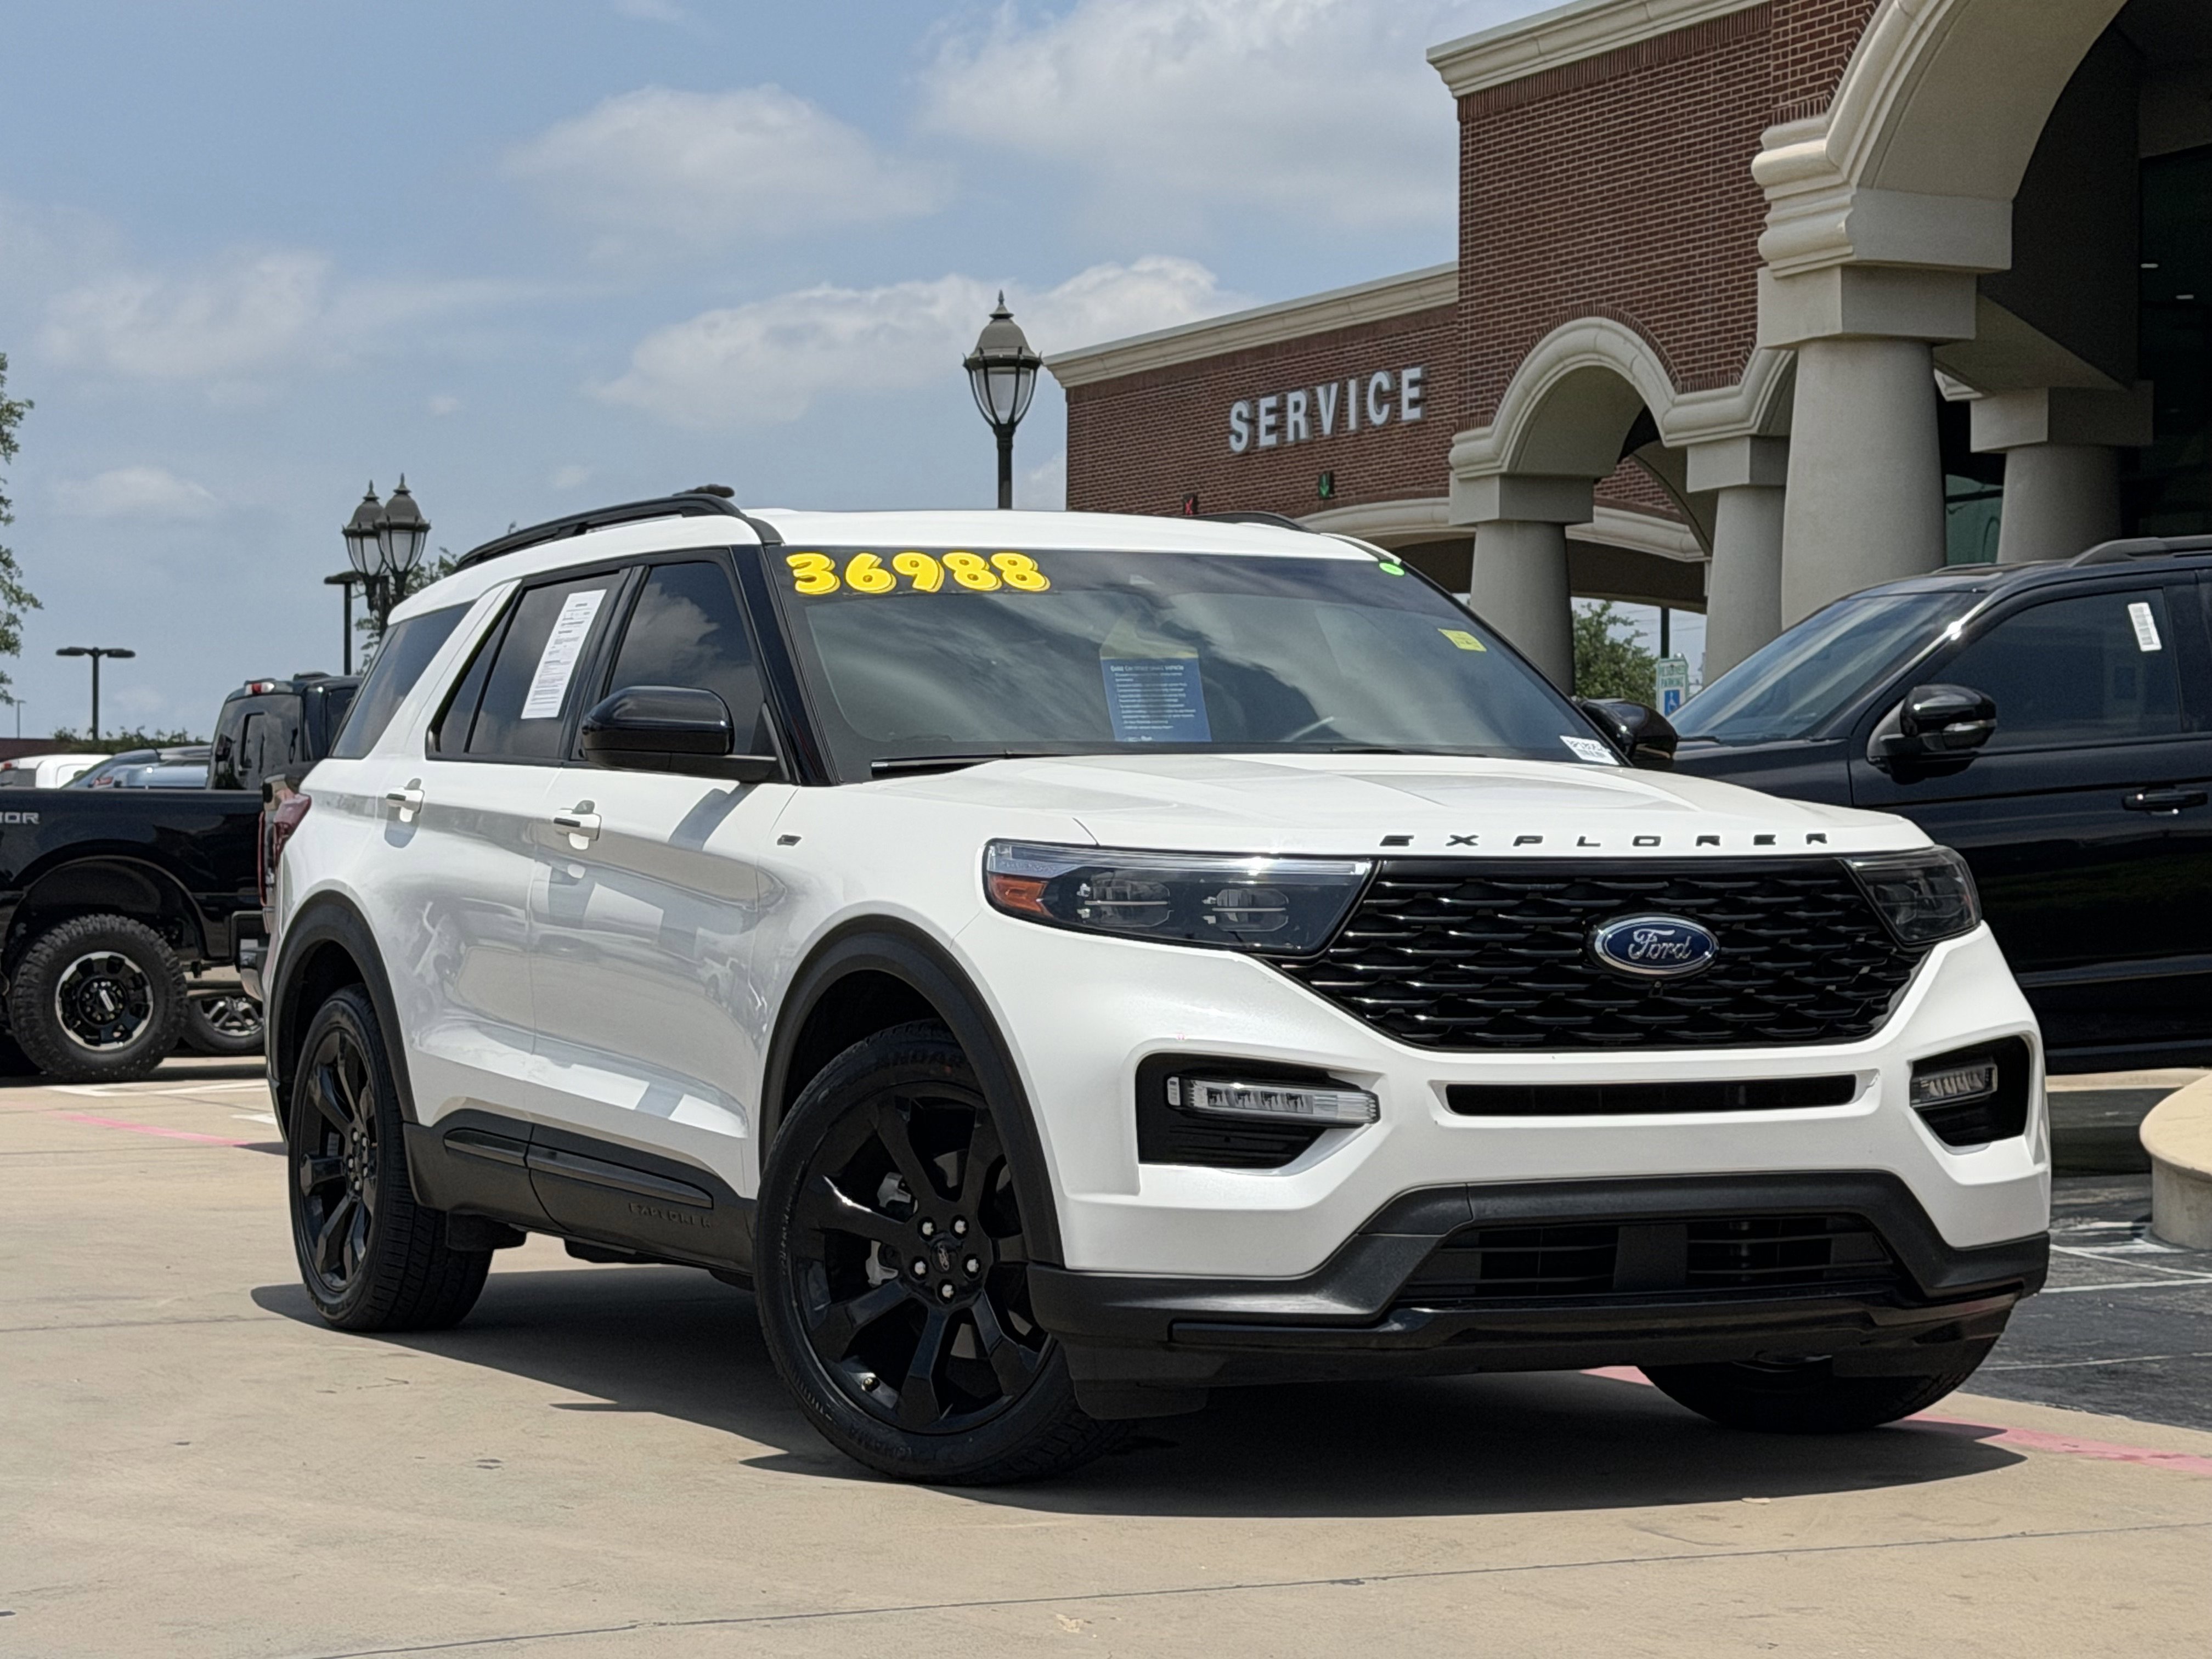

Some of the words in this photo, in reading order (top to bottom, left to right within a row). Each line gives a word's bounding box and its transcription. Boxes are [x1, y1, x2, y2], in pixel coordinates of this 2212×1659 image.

[1229, 366, 1425, 454] SERVICE
[787, 552, 1051, 594] 36988
[0, 812, 39, 824] OR
[1379, 833, 1827, 847] EXPLORER
[1628, 928, 1692, 960] Ford
